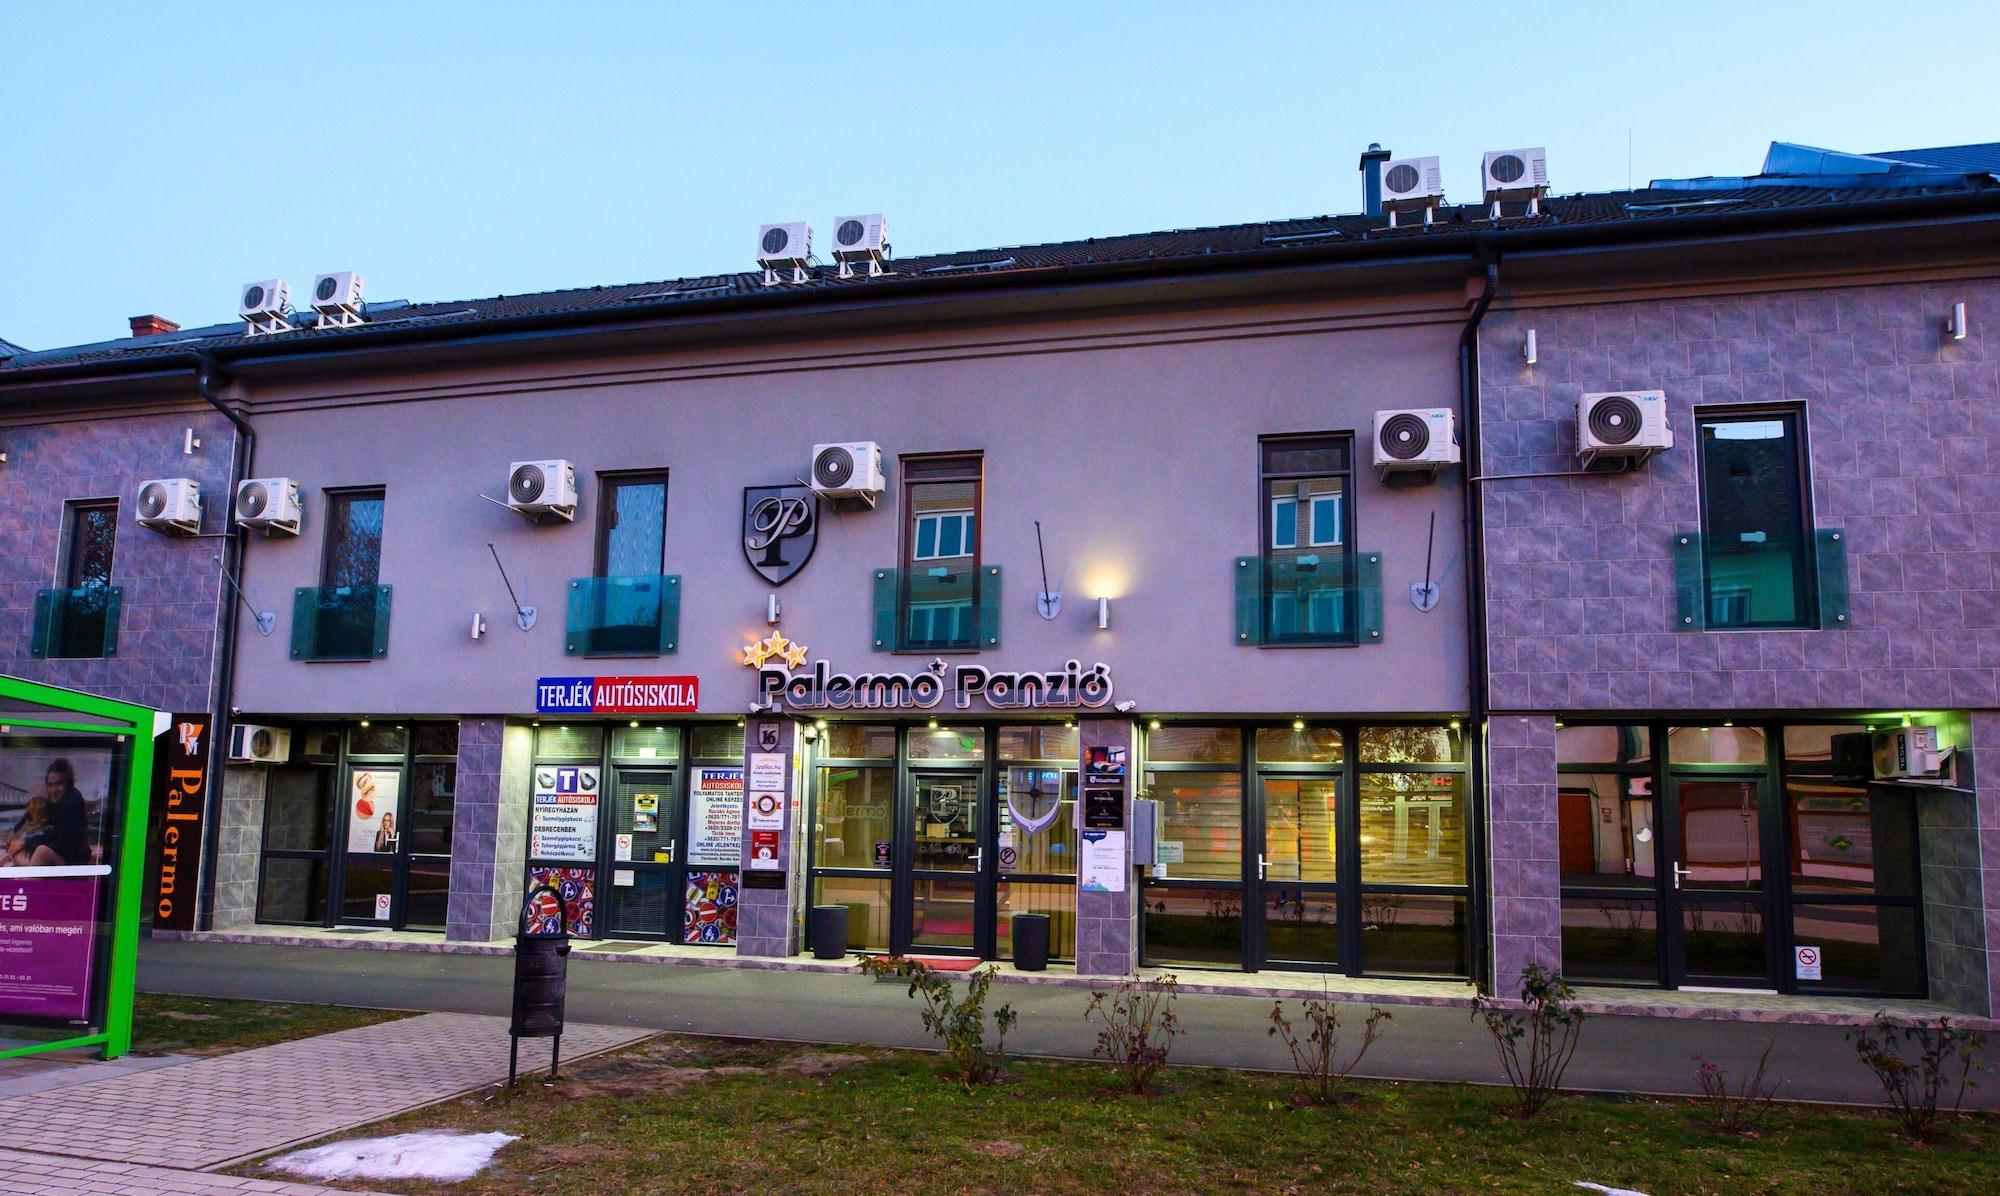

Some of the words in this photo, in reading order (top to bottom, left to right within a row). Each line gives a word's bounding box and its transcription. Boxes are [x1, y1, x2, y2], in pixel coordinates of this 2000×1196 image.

[540, 681, 592, 707] TERJÉK
[595, 680, 695, 706] AUTÓSISKOLA
[758, 661, 943, 708] Palermo
[955, 660, 1113, 709] Panzió
[762, 730, 777, 745] 16
[559, 770, 576, 790] T
[158, 766, 204, 919] Palermo
[9, 924, 23, 932] ami
[24, 924, 54, 933] valóban
[55, 925, 83, 936] megéri
